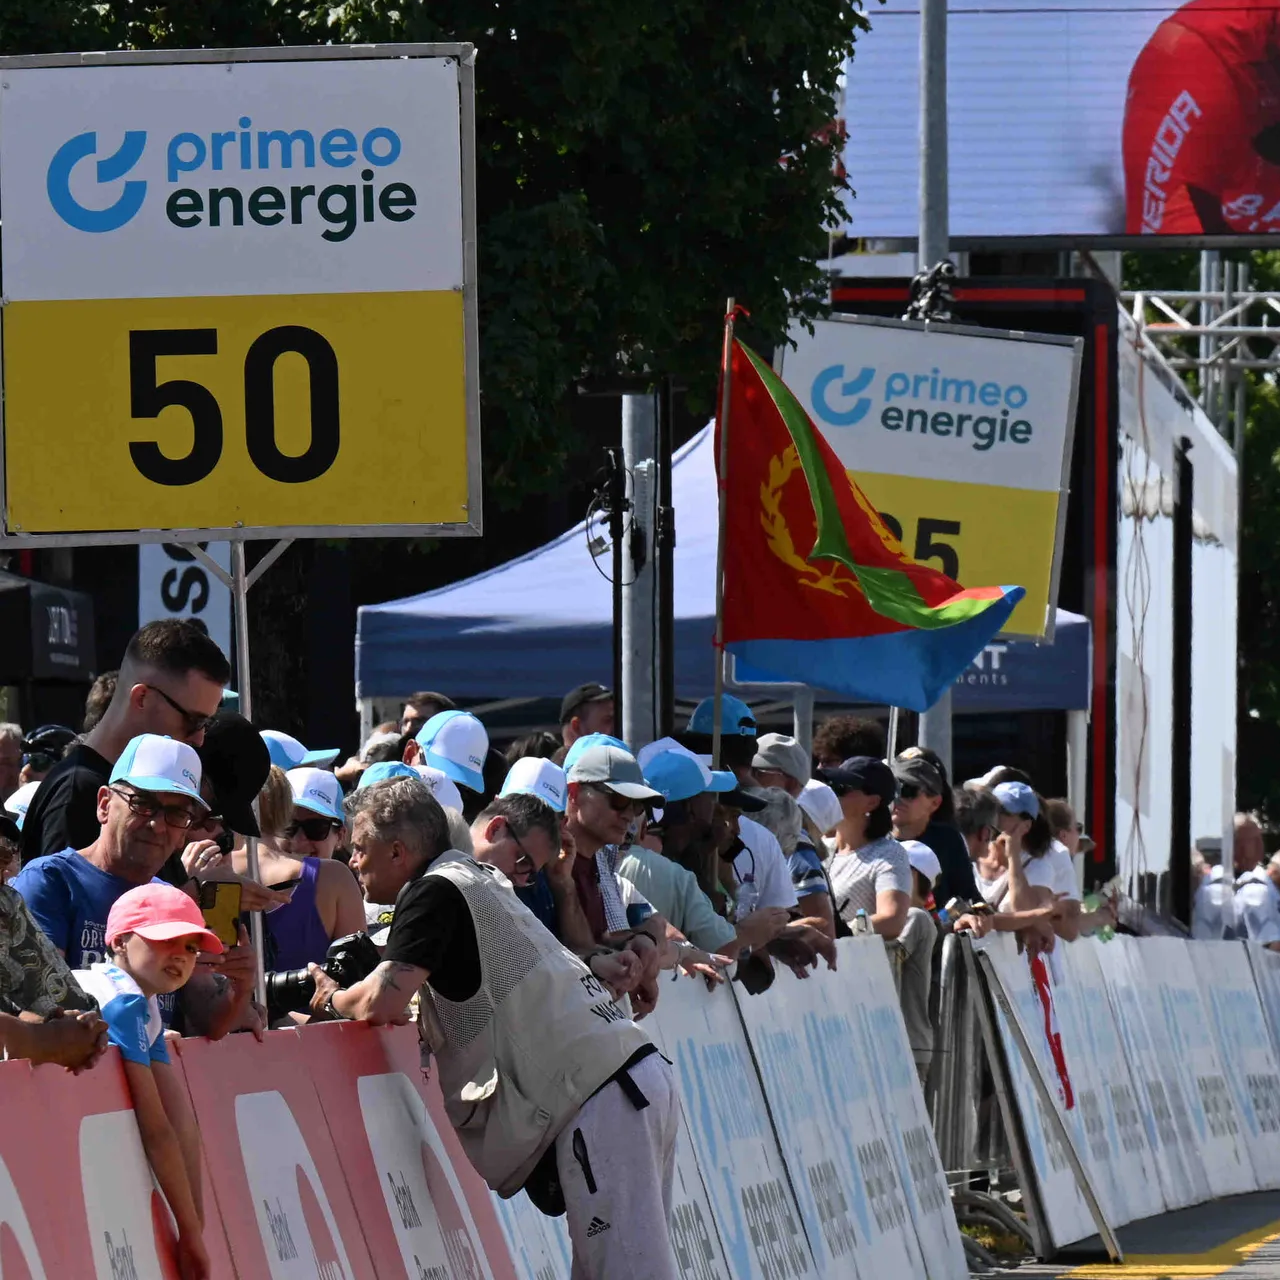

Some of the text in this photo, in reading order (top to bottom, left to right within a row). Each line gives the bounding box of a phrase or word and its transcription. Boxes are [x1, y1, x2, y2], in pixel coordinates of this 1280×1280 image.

[166, 116, 402, 183] primeo
[1141, 89, 1203, 234] ERIDA
[165, 169, 417, 243] energie
[128, 324, 341, 487] 50
[884, 367, 1028, 410] primeo
[880, 401, 1033, 451] energie
[878, 511, 961, 583] 5
